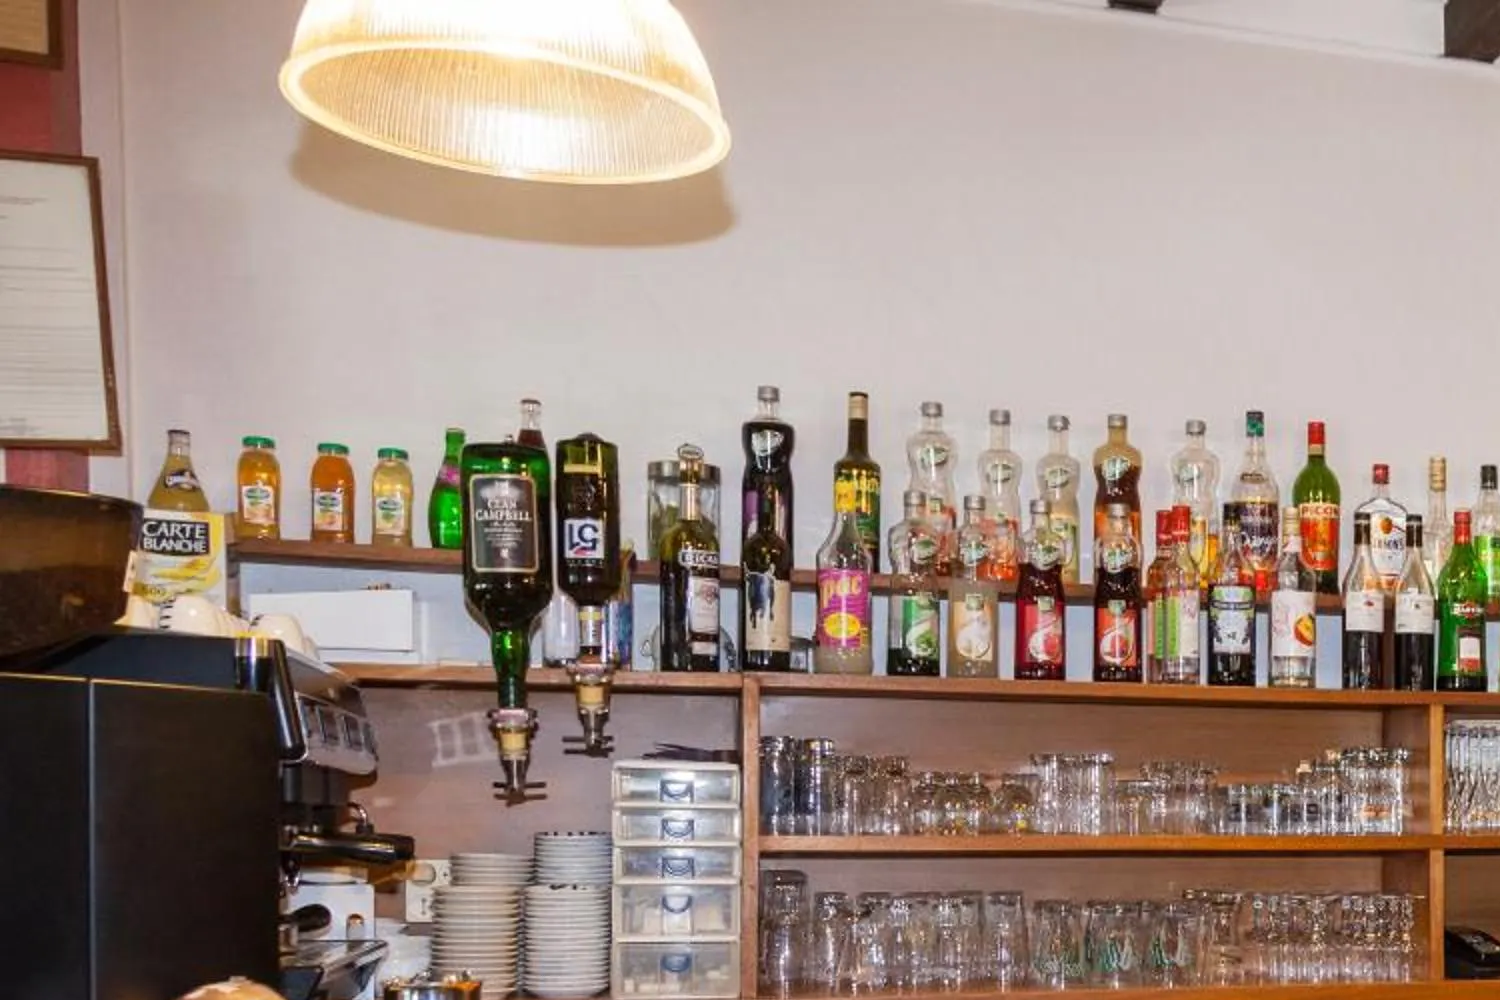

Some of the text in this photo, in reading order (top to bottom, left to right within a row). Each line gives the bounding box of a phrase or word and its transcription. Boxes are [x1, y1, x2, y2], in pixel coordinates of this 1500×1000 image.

[142, 521, 207, 539] CARTE
[568, 523, 598, 550] 51
[143, 537, 207, 553] BLANCHE
